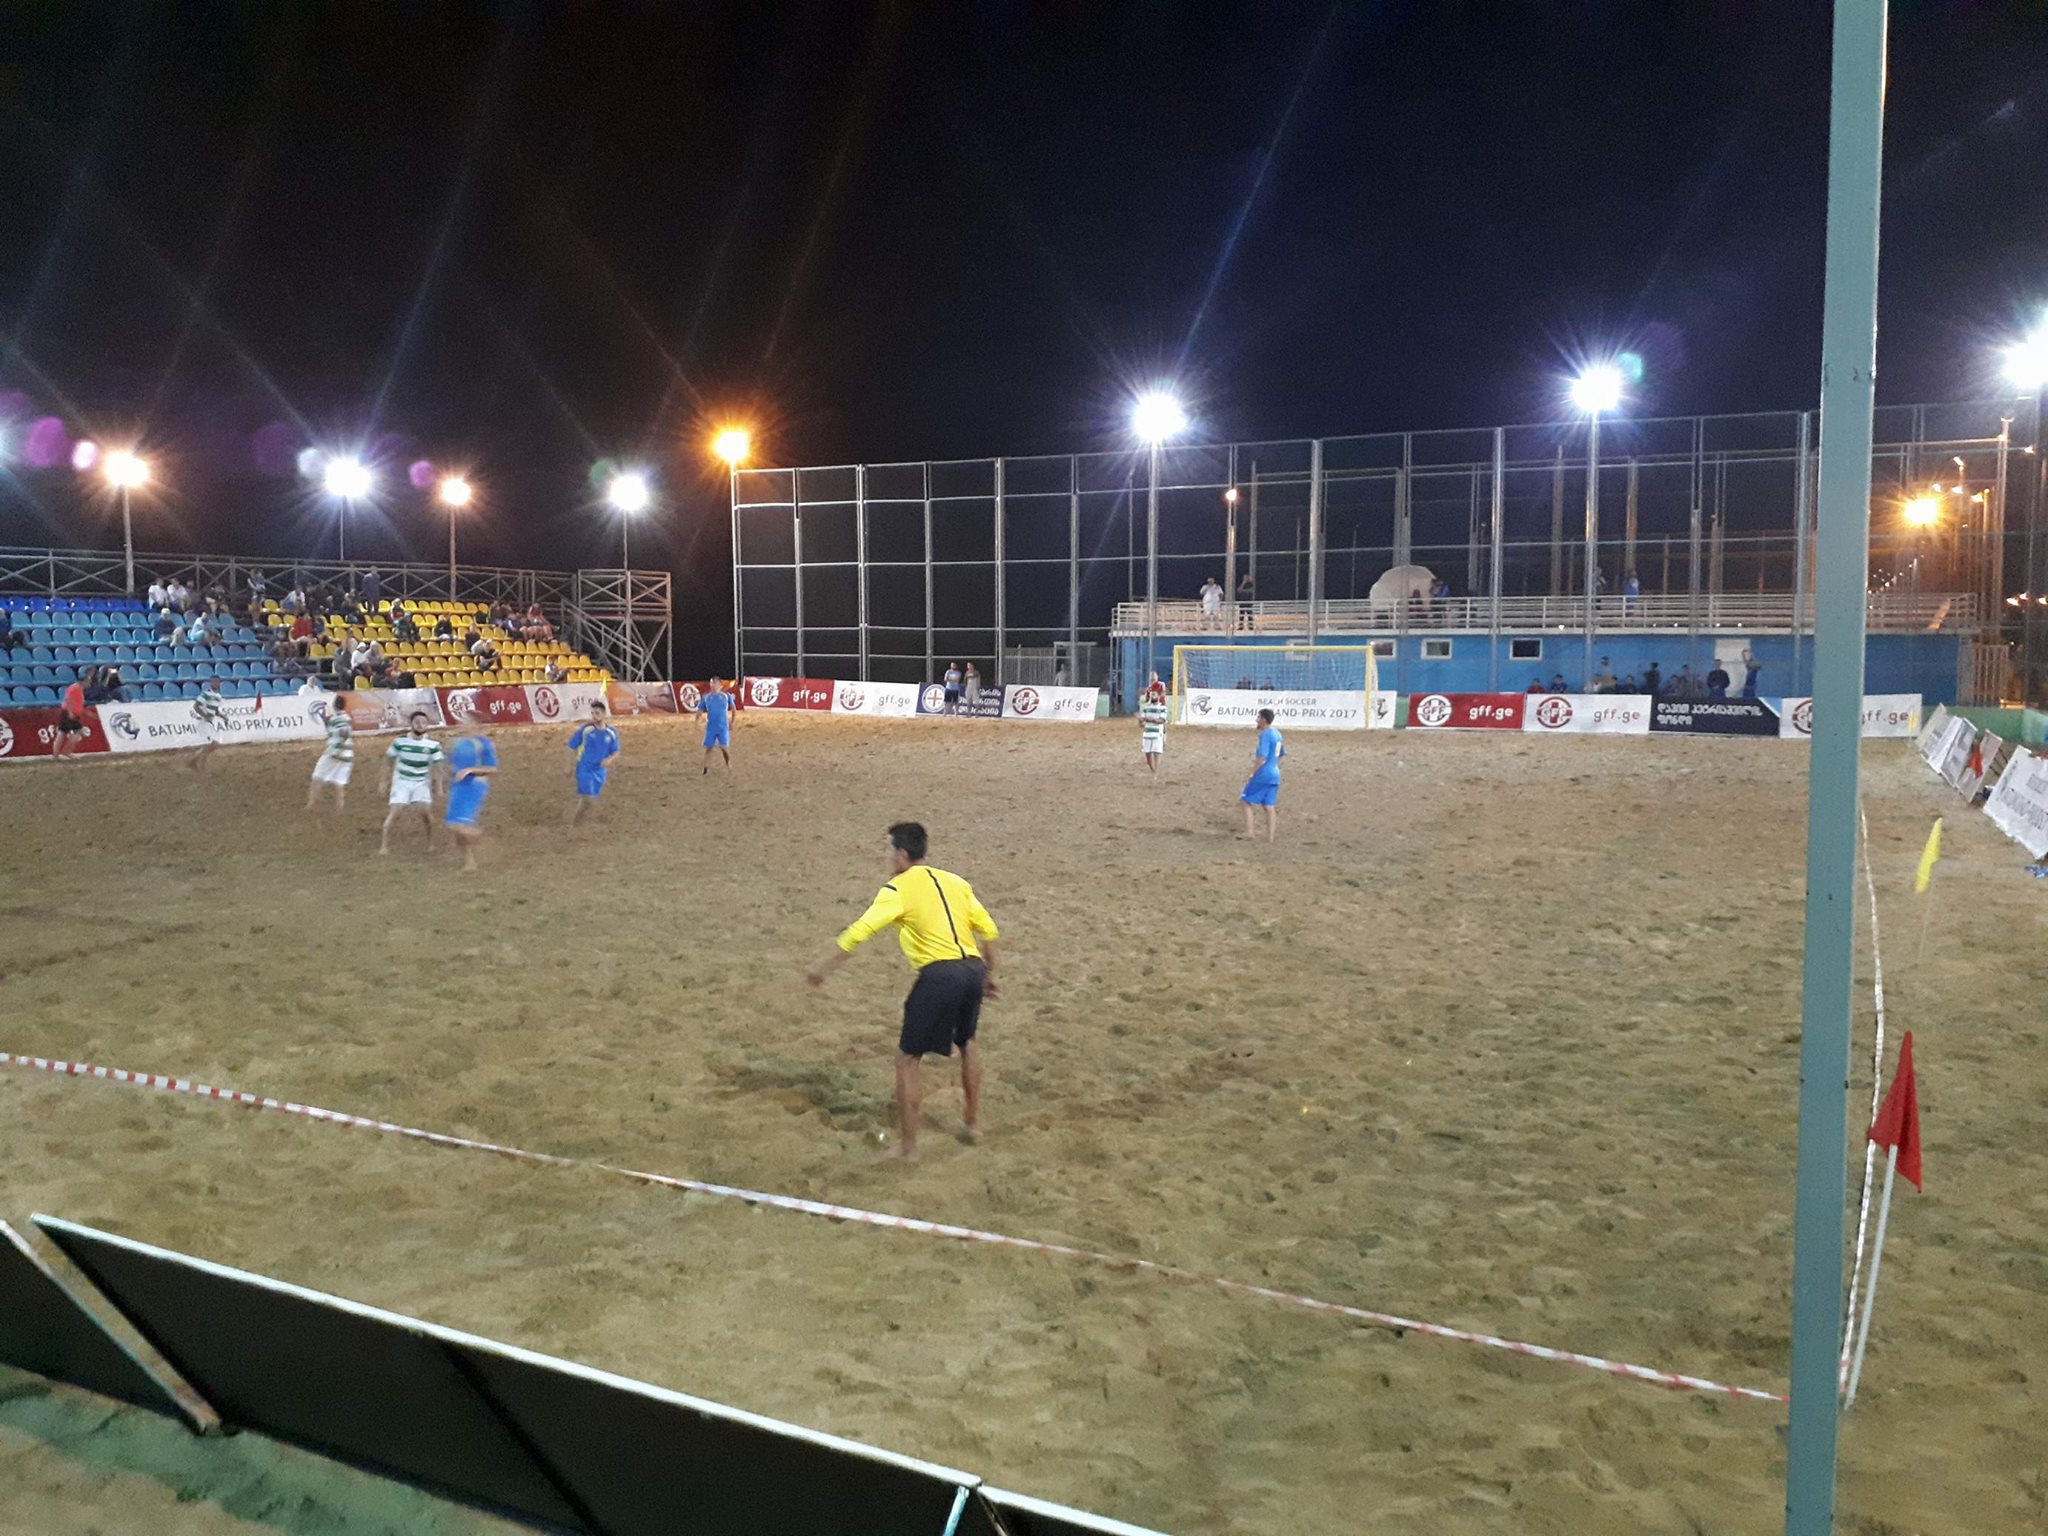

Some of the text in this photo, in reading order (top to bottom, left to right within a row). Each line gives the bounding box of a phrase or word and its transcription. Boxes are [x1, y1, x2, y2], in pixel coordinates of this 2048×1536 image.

[755, 688, 774, 696] GFF
[793, 689, 828, 703] gff.ge
[878, 695, 911, 707] gff.ge
[1015, 698, 1035, 706] GFF
[1054, 699, 1090, 711] gff.ge
[1285, 698, 1317, 706] SOCCER
[489, 701, 522, 714] gff.ge
[1273, 707, 1327, 717] AND-PRIX
[1329, 709, 1357, 719] 2017
[1421, 706, 1446, 715] GFF
[1469, 704, 1514, 720] gff.ge
[1542, 707, 1567, 716] GFF
[1593, 708, 1641, 723] gff.ge
[148, 716, 304, 737] BATUMI AND-PRIX 2017
